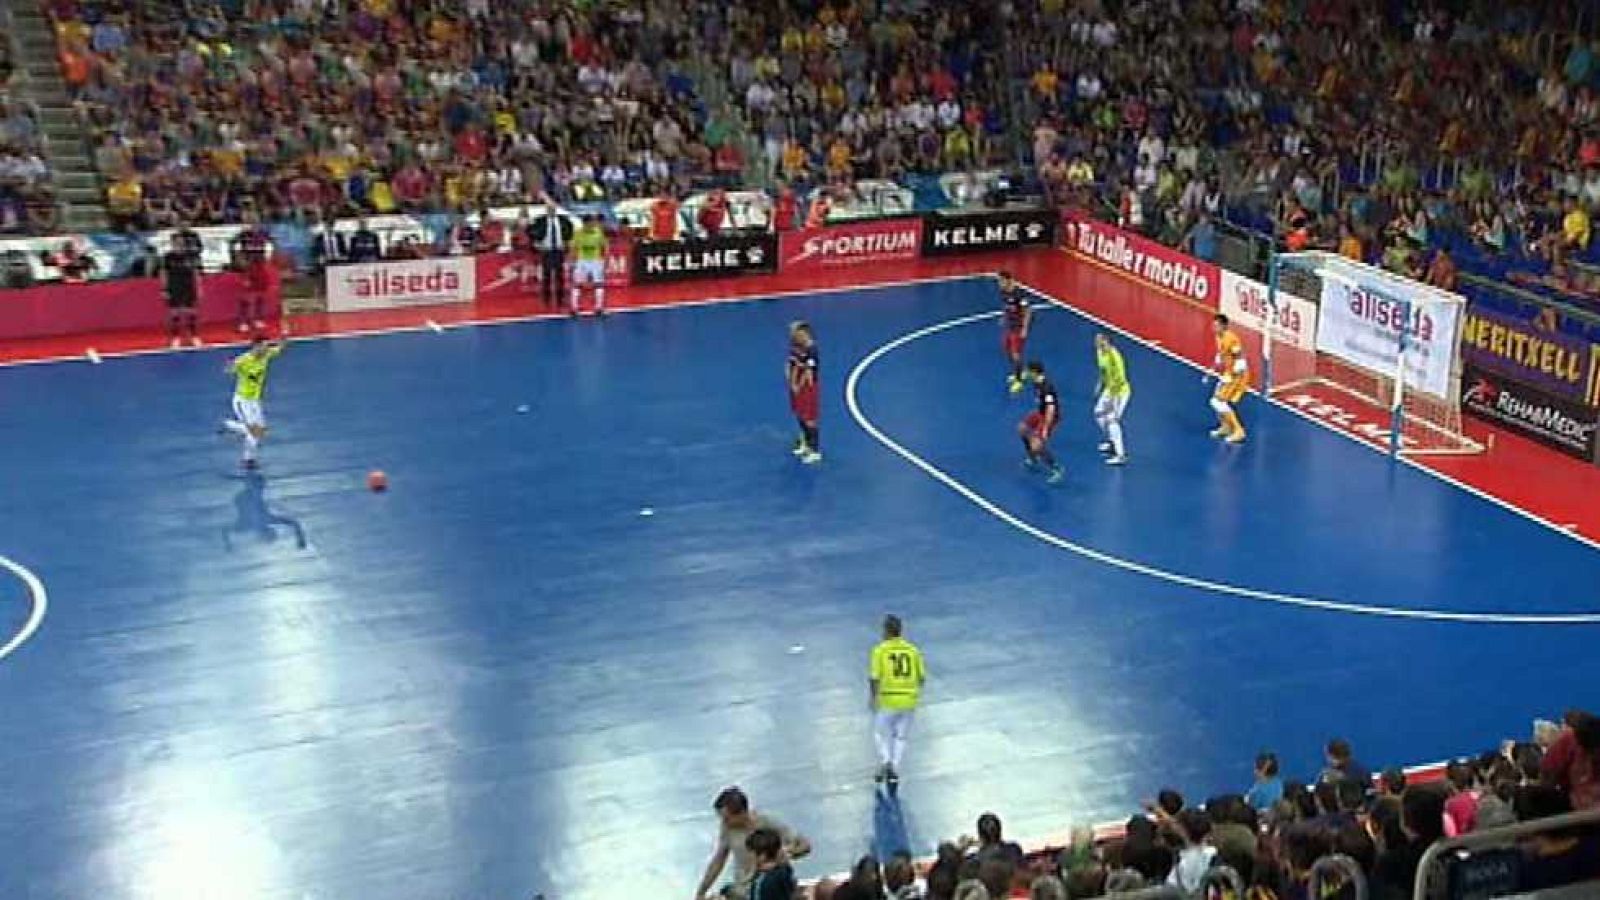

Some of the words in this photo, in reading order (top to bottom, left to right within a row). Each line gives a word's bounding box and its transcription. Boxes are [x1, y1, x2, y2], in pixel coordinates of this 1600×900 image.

[785, 231, 916, 264] SPORTIUM
[933, 222, 1020, 247] KELME
[646, 248, 742, 273] KELME
[1078, 222, 1096, 255] Tu
[1142, 253, 1209, 300] motrio
[352, 267, 460, 298] aliseda
[888, 652, 912, 678] 10
